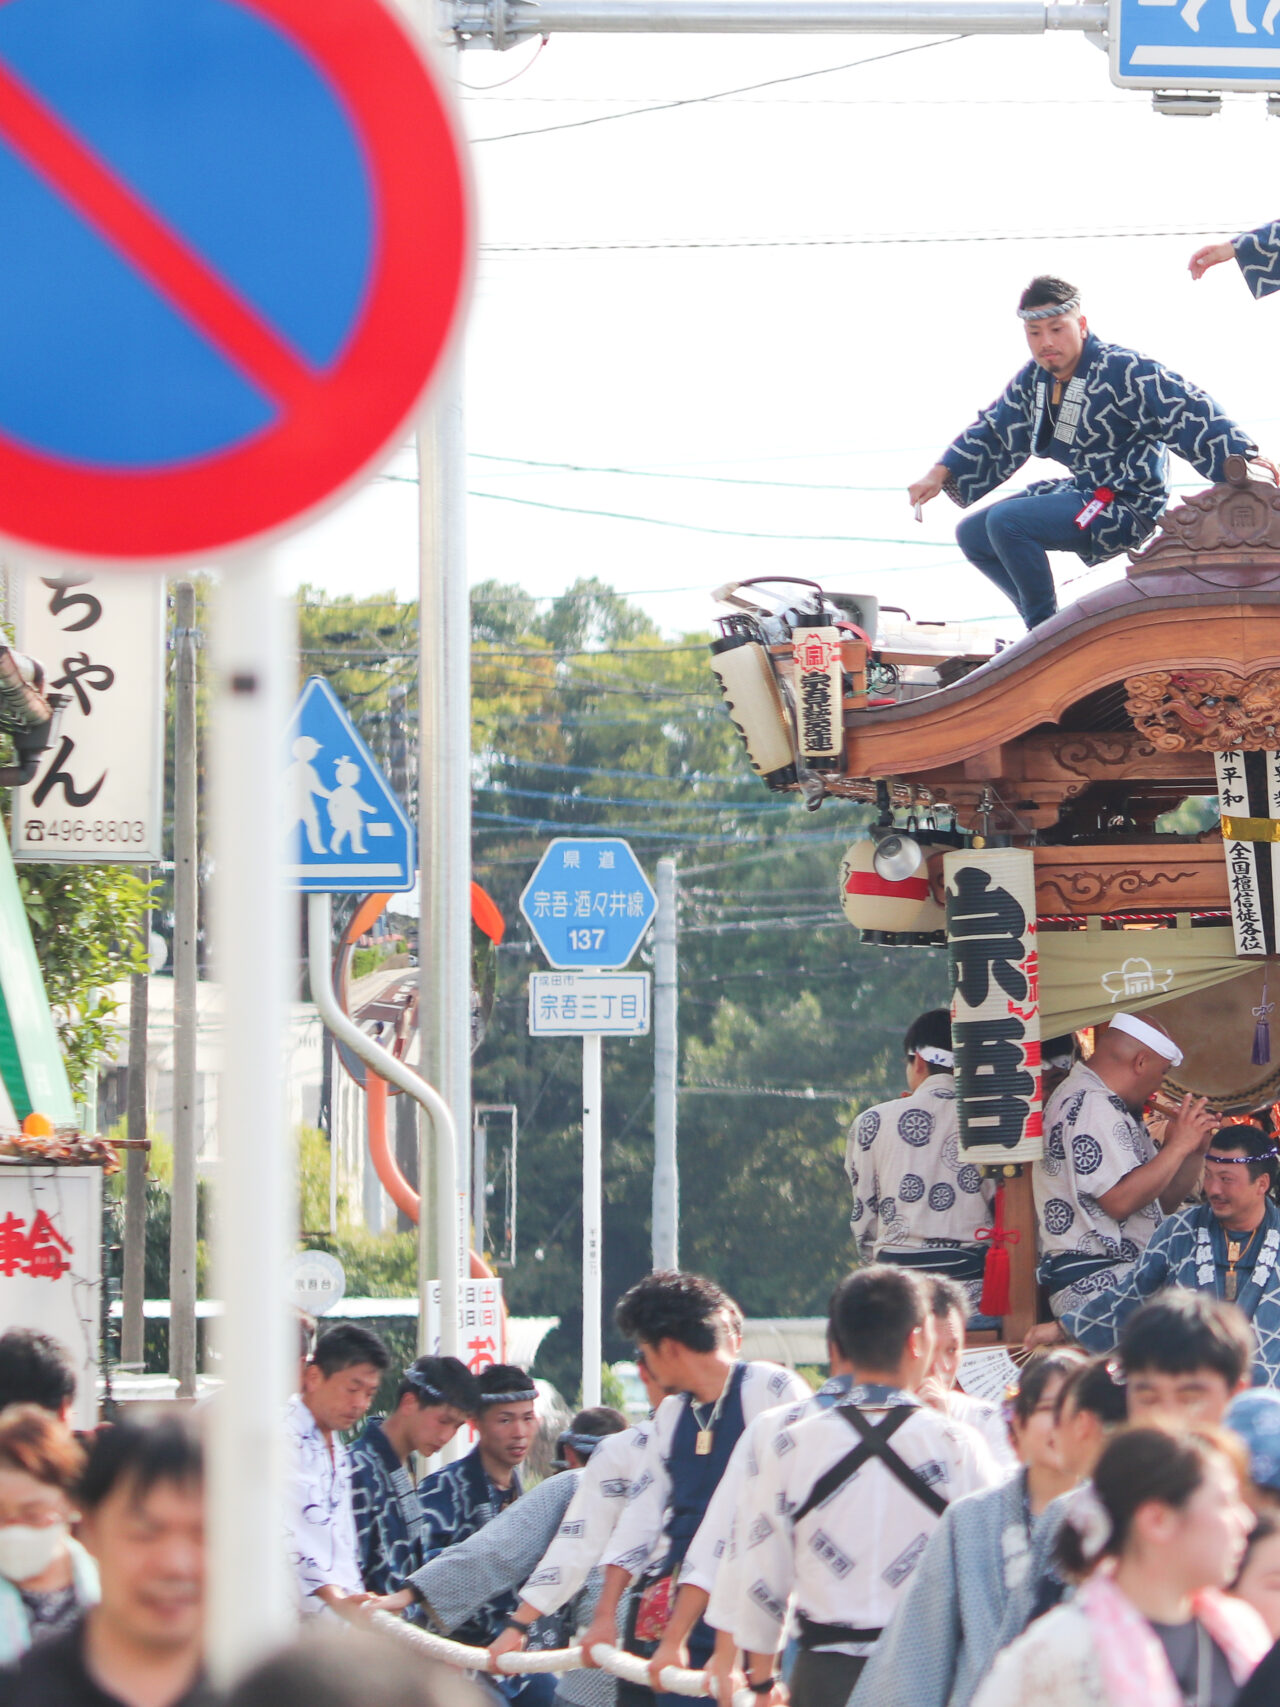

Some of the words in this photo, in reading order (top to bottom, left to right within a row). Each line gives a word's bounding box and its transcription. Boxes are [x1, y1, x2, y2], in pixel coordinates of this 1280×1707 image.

[47, 819, 145, 843] 496-8803
[563, 850, 616, 869] 県道
[568, 928, 606, 951] 137
[540, 994, 637, 1020] 宗吾三丁目
[944, 866, 1036, 1151] 宗吾
